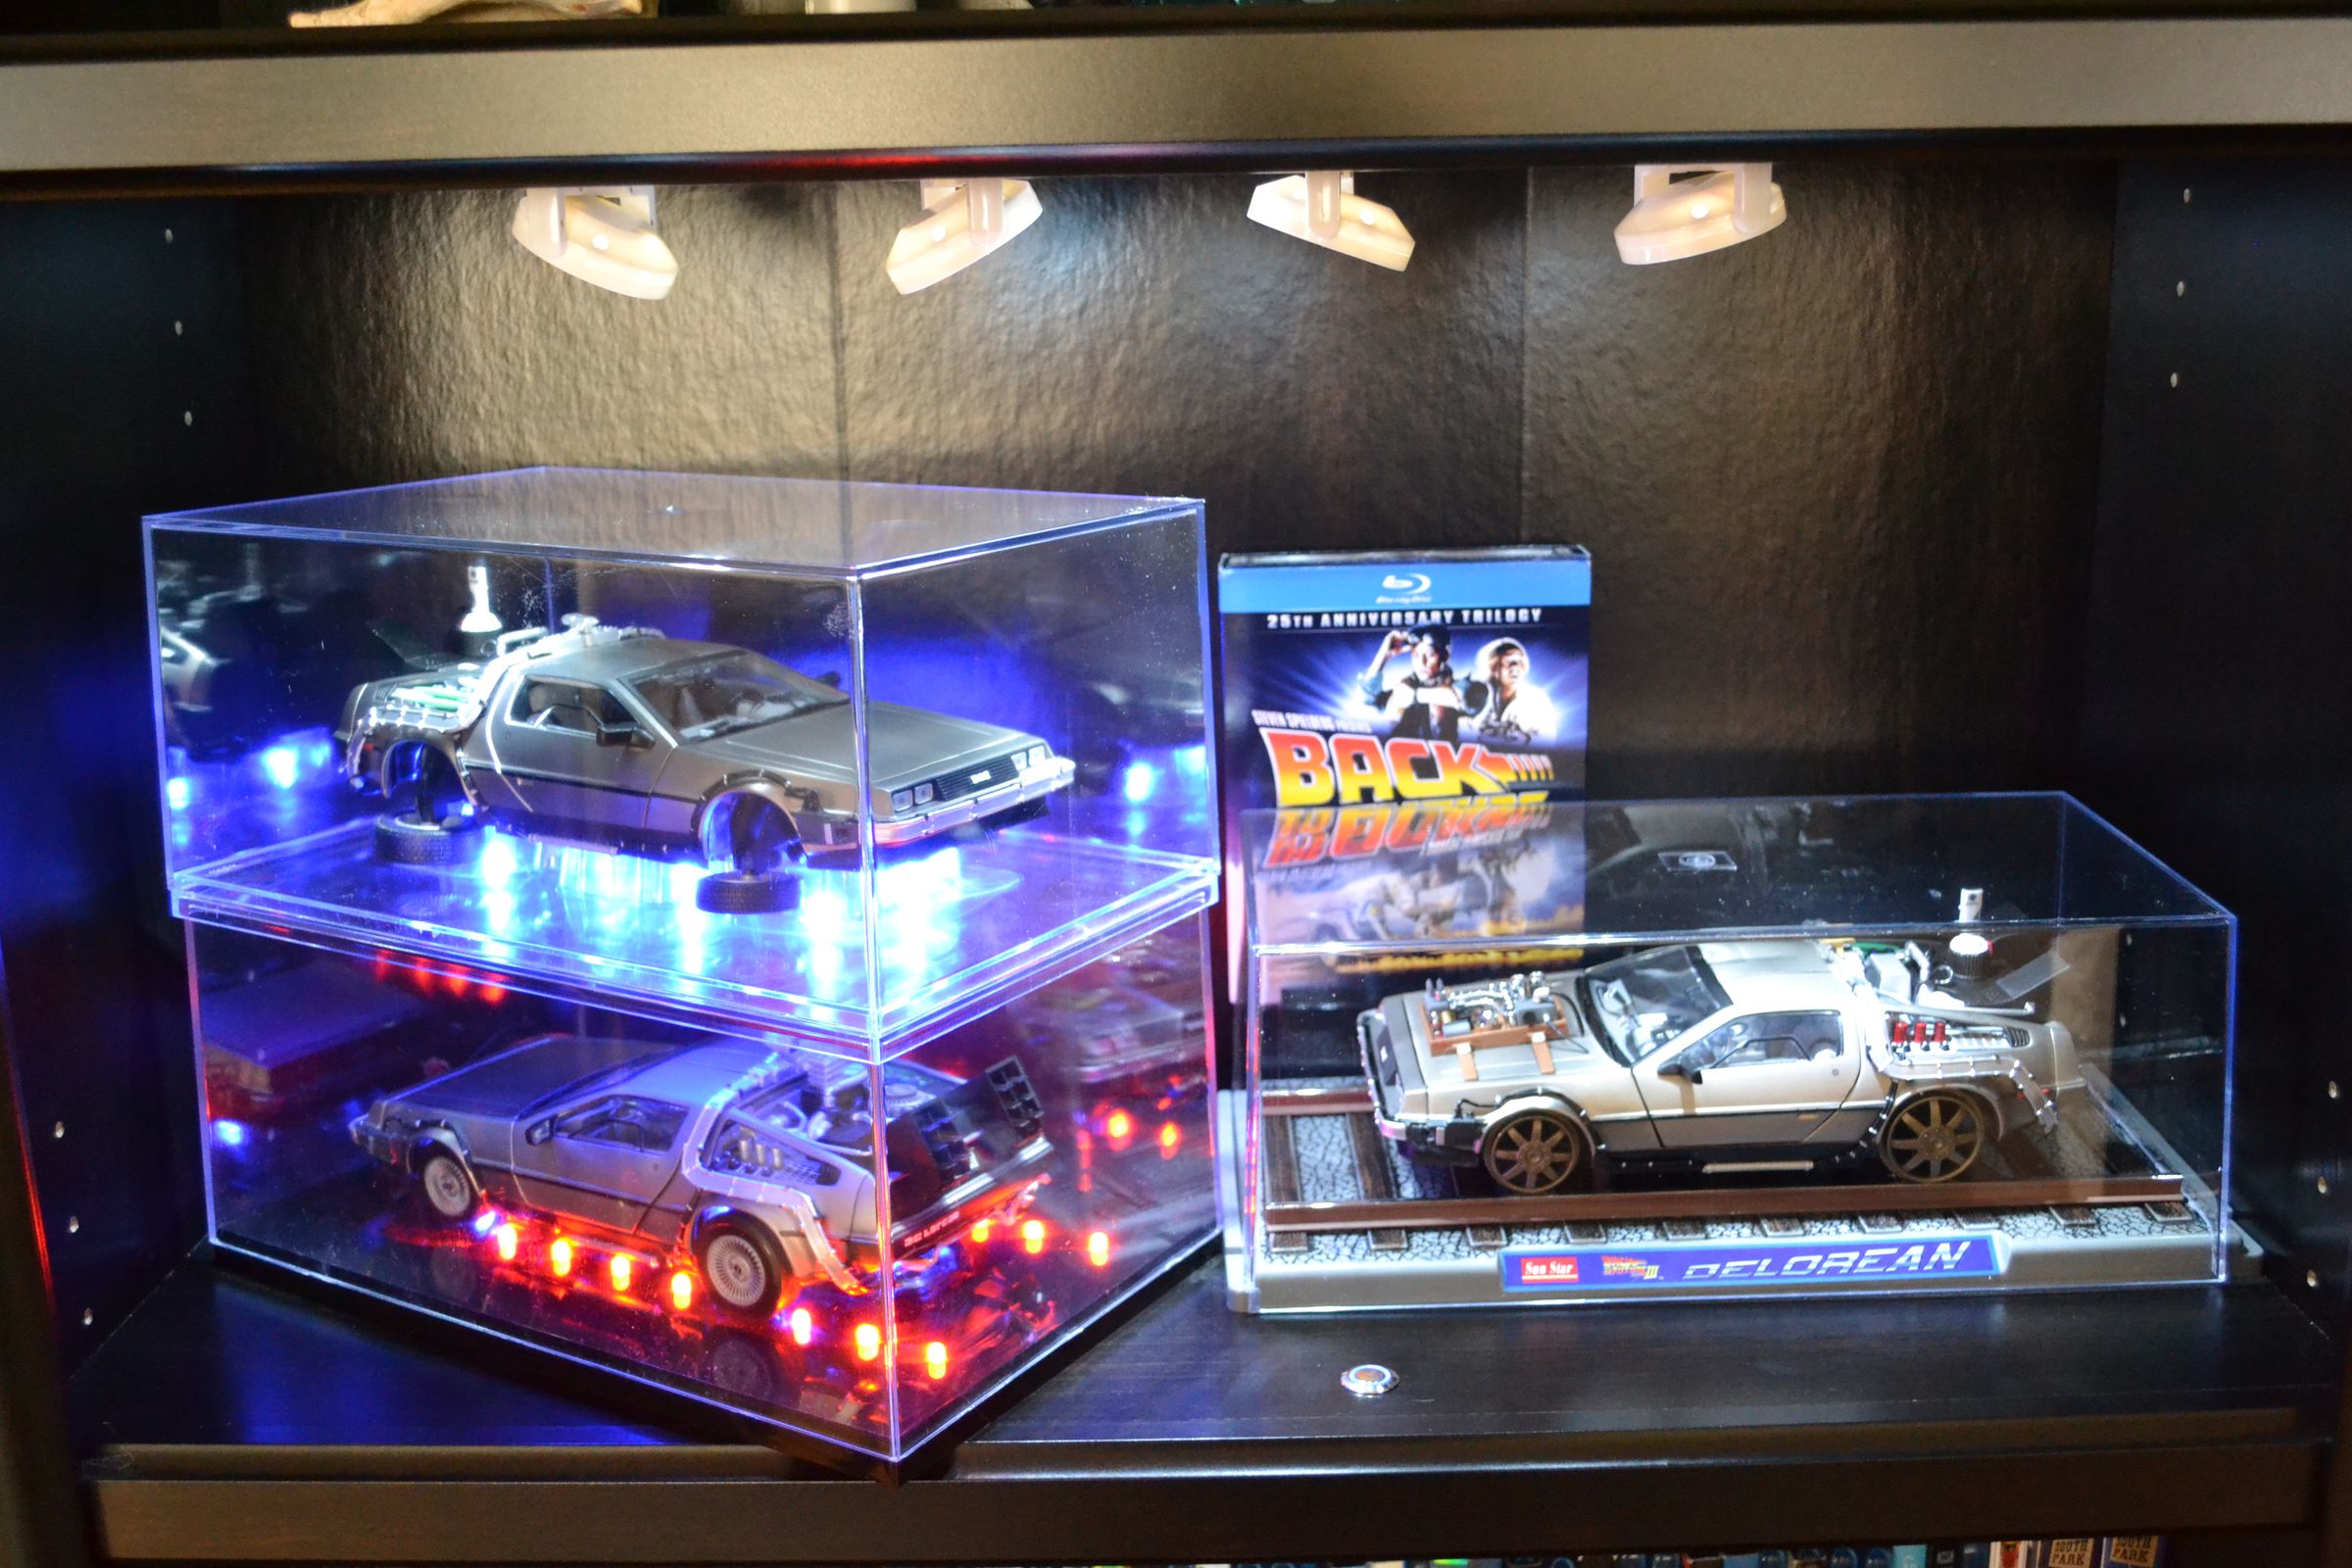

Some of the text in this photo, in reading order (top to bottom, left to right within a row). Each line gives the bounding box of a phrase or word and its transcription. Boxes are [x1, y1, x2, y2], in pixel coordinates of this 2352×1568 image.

[1266, 608, 1543, 629] 25TH ANNIVERSARY TRILOGY
[1258, 727, 1511, 808] BACK
[1525, 1259, 1573, 1275] Sun Star
[1682, 1241, 1971, 1280] DELOREAN
[2051, 1552, 2085, 1565] PARK
[2112, 1547, 2150, 1563] PARK
